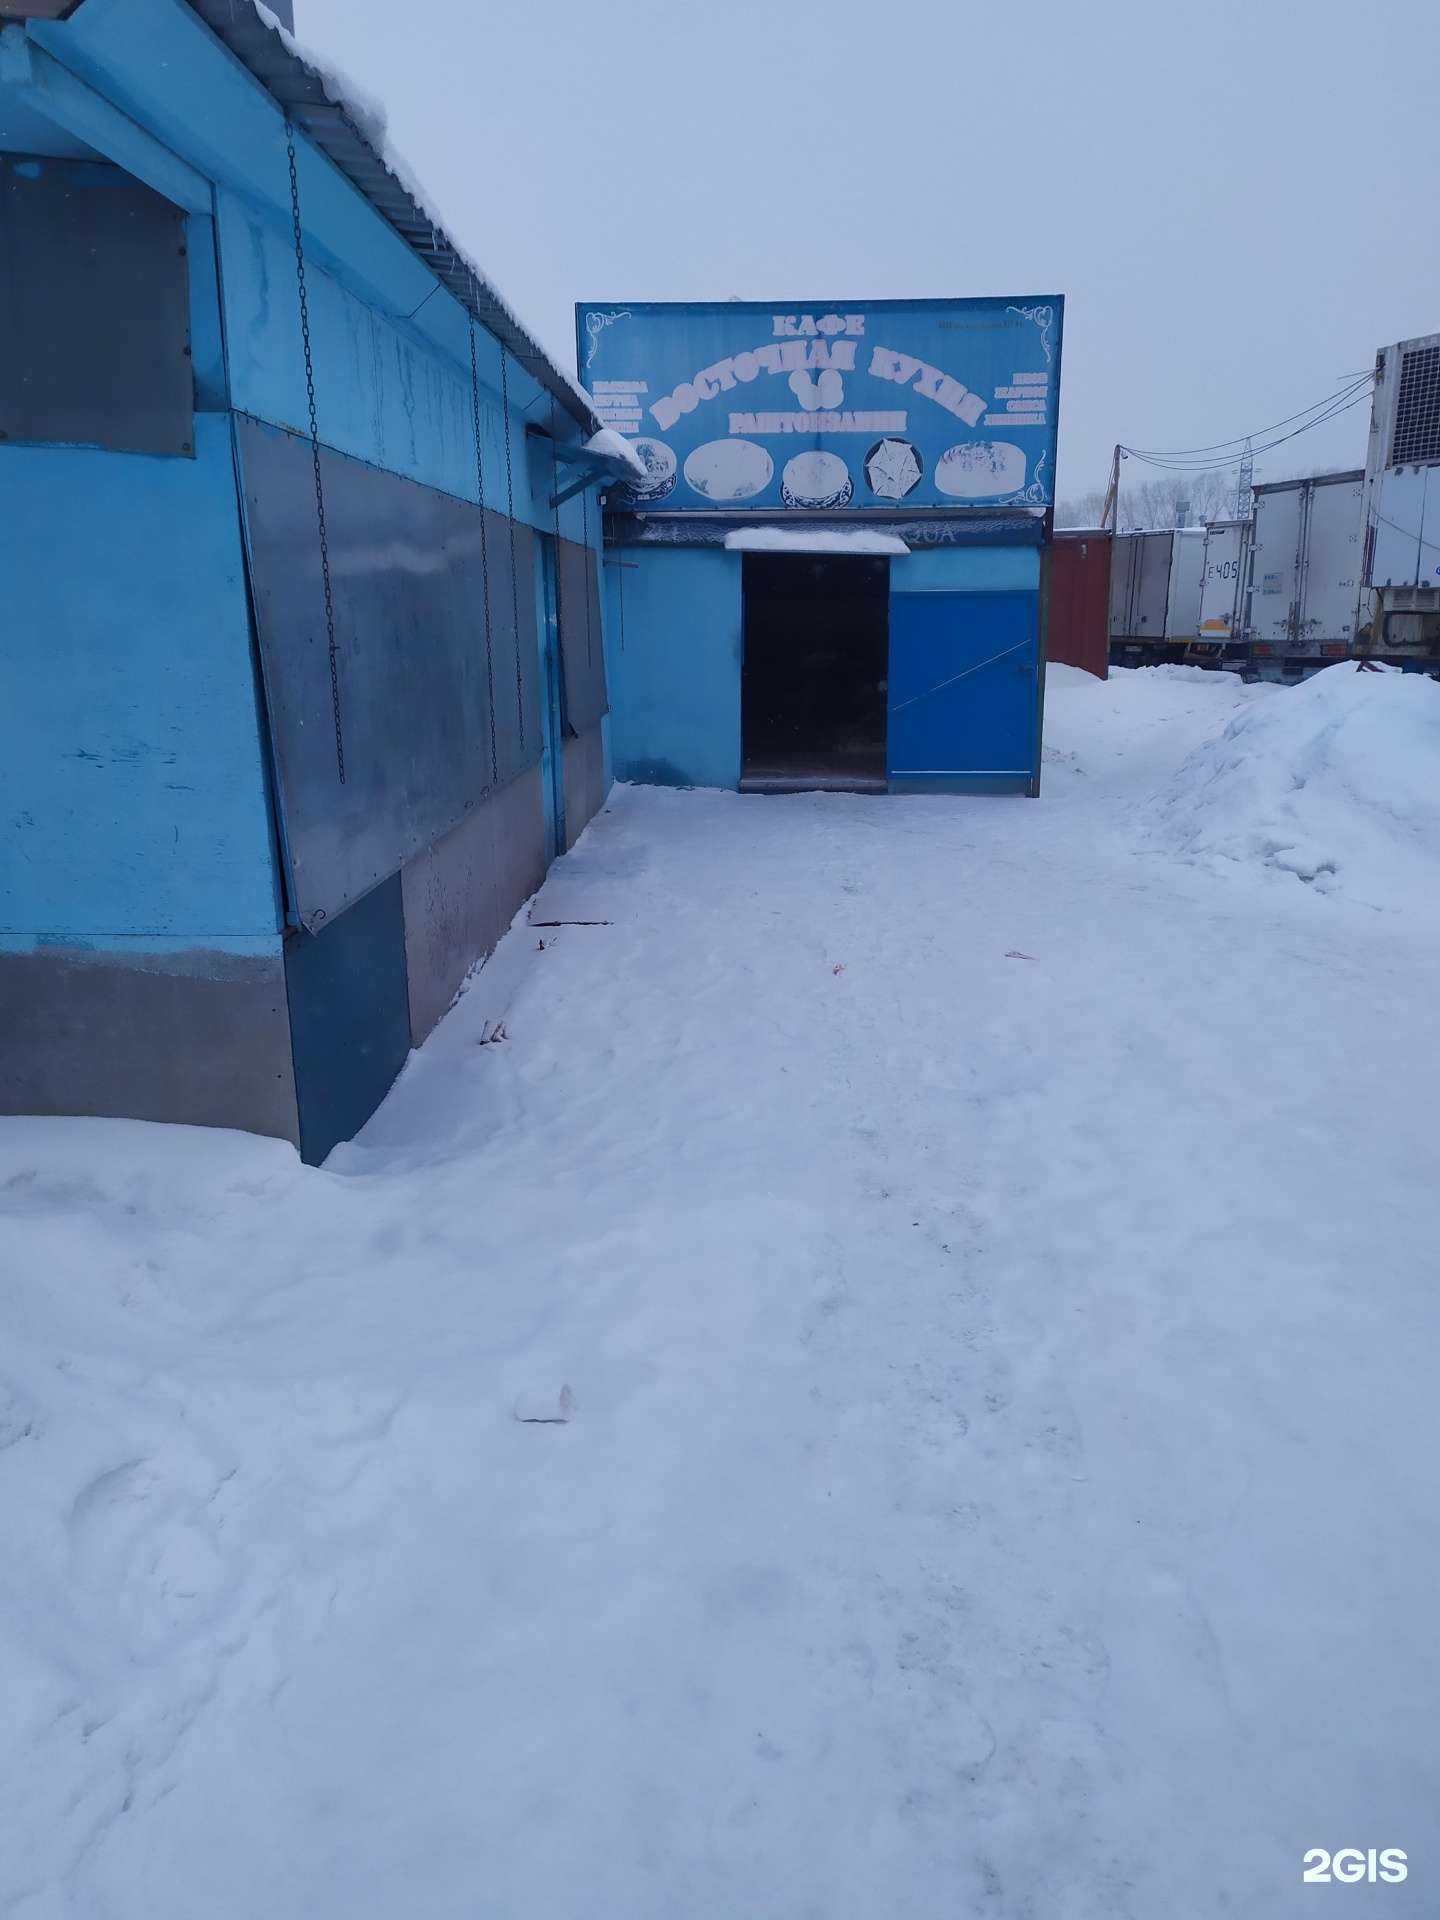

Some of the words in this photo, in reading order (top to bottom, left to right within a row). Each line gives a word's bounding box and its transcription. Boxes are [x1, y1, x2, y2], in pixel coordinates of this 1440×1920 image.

[773, 315, 865, 336] КАФЕ
[649, 340, 858, 431] ВОСТОЧНАЯ
[868, 346, 988, 428] КУХНЯ
